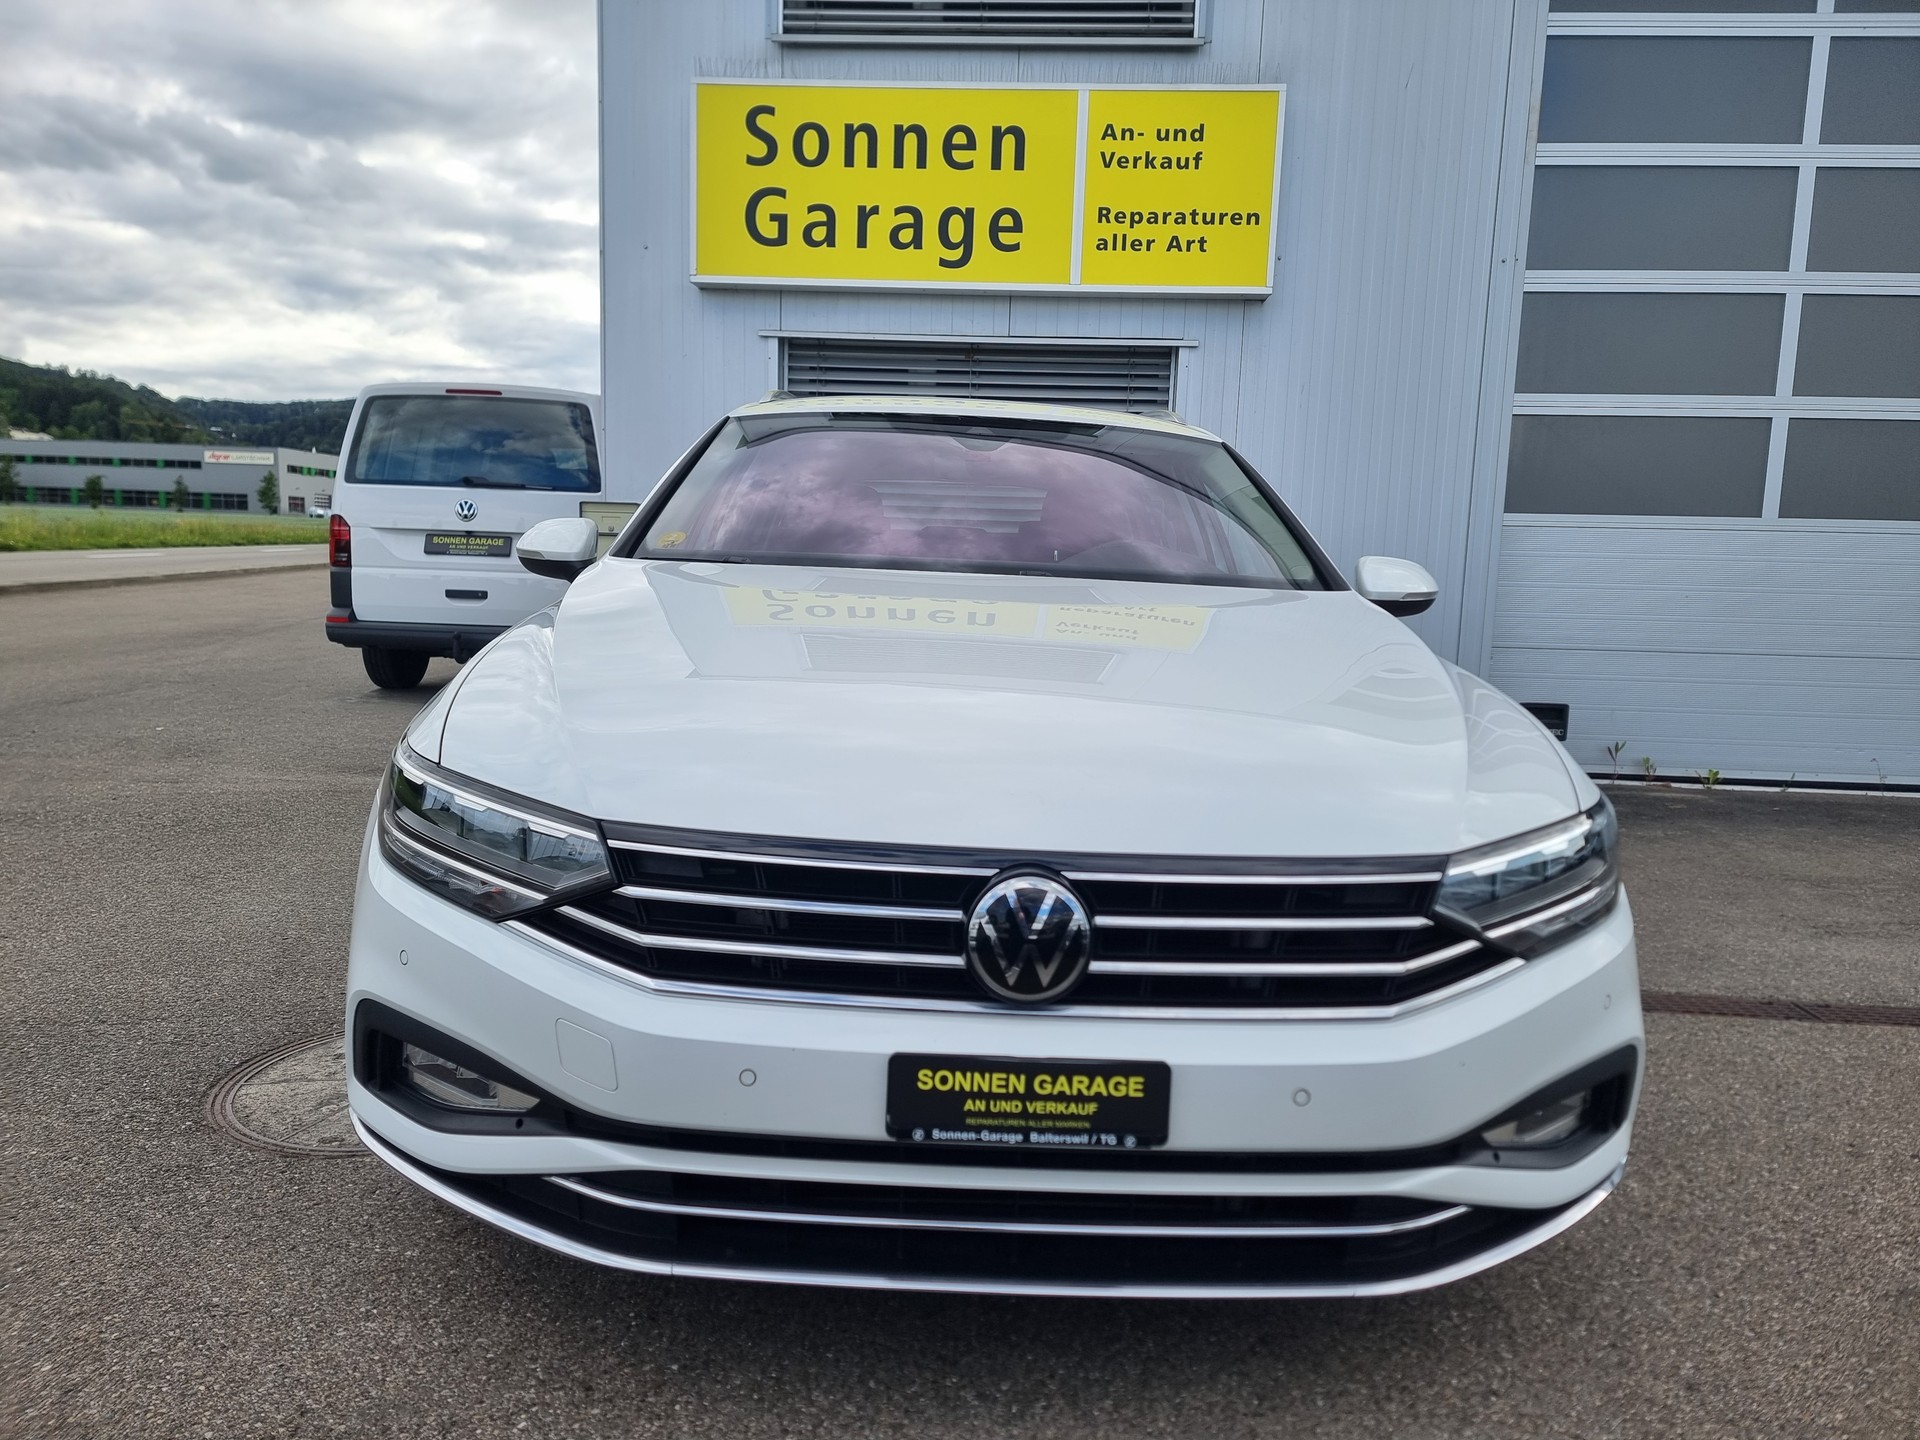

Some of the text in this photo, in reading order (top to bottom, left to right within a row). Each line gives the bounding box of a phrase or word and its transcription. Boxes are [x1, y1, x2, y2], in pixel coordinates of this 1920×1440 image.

[745, 104, 1026, 171] Sonnen
[1100, 123, 1205, 142] An- und
[1100, 150, 1204, 170] Verkauf
[744, 186, 1024, 269] Garage
[1097, 206, 1260, 229] Reparaturen
[1095, 233, 1208, 253] aller Art
[432, 536, 504, 546] SONNEN GARAGE
[917, 1068, 1145, 1098] SONNEN GARAGE
[963, 1099, 1099, 1115] AN UND VERKAUF
[931, 1127, 1024, 1145] Sonnen-Garage
[1100, 1133, 1118, 1146] TG
